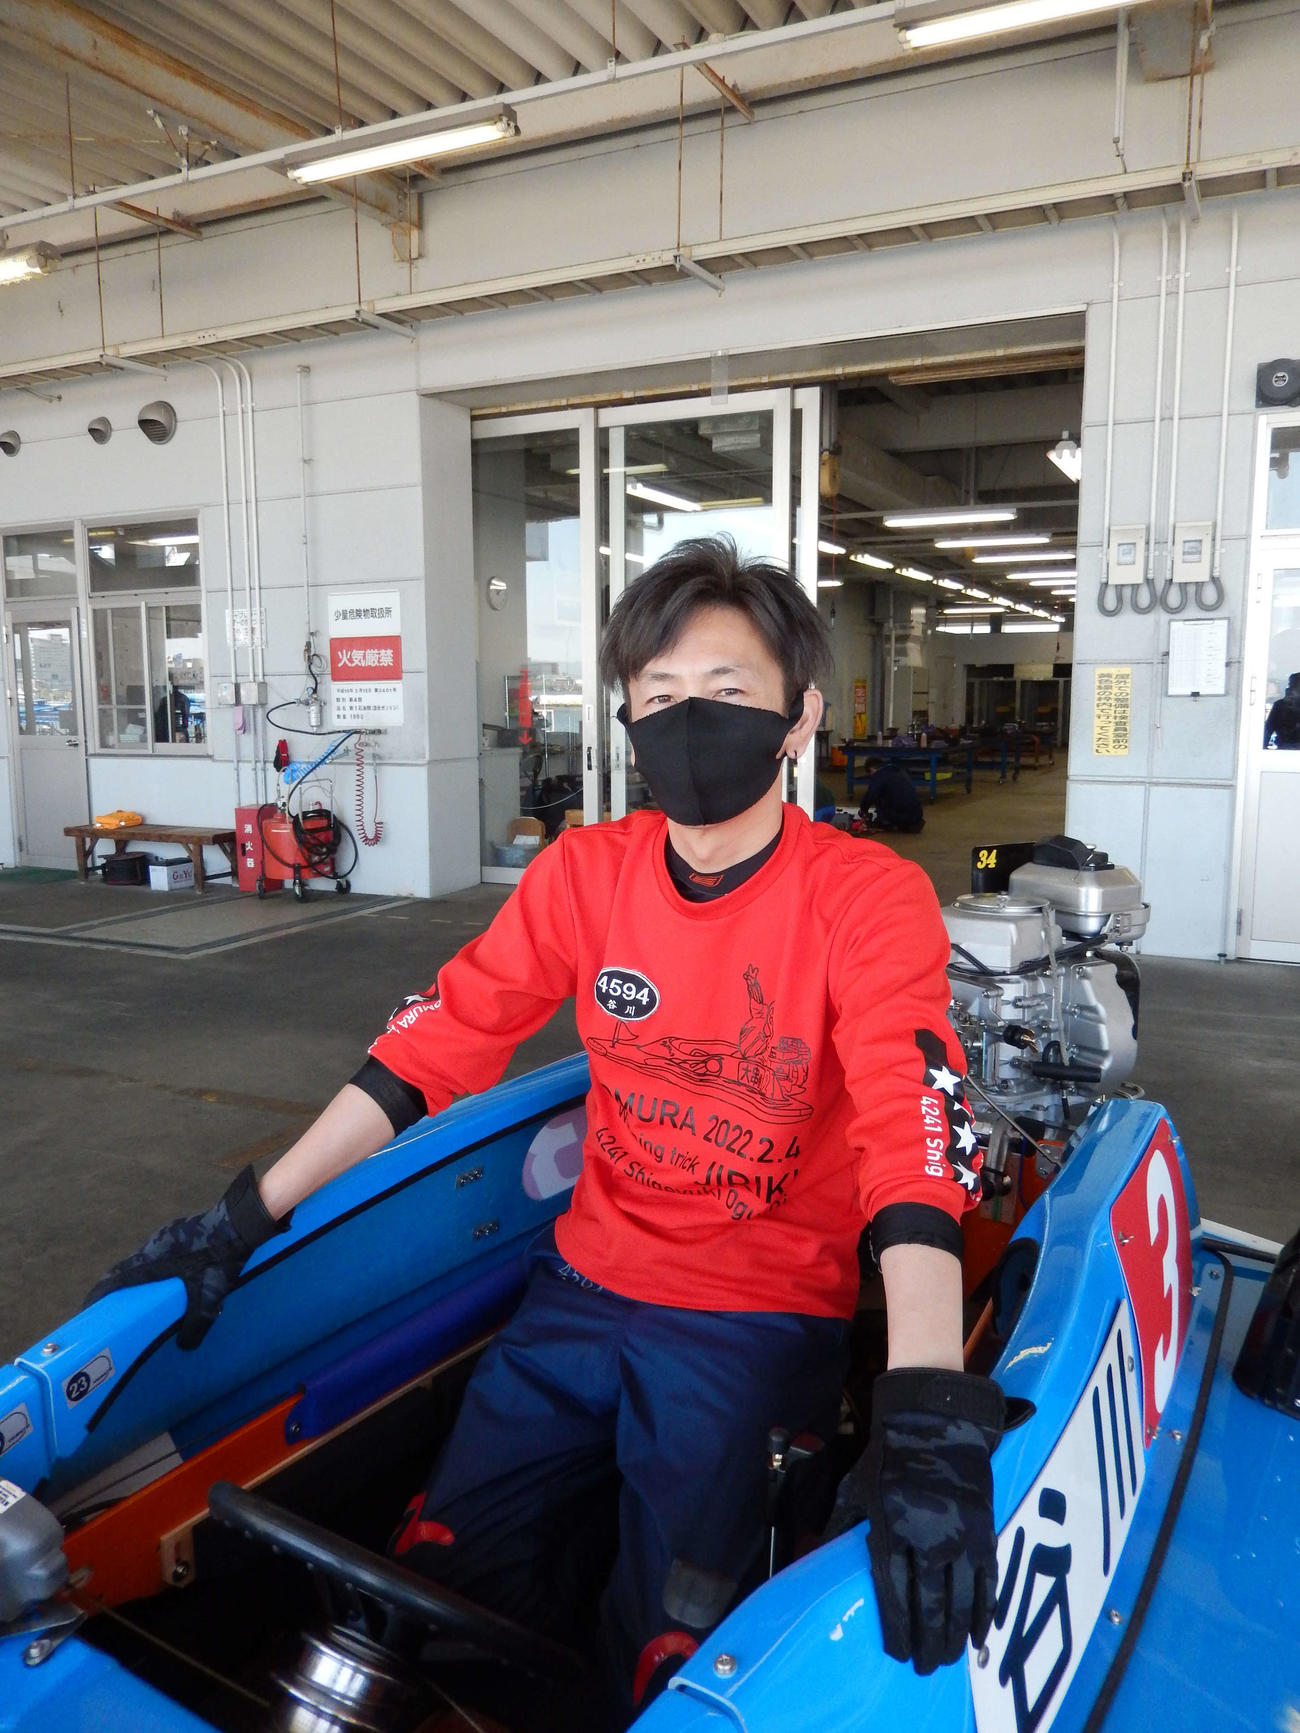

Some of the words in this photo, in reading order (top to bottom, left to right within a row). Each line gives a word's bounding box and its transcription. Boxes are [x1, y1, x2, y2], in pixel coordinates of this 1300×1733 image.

[334, 607, 392, 621] 少量危険物取扱所
[338, 649, 394, 667] 火気厳禁
[244, 824, 255, 868] 消火器
[976, 849, 997, 869] 34
[597, 975, 650, 1005] 4594
[607, 999, 636, 1016] 谷川
[920, 1095, 943, 1132] 4241
[703, 1114, 800, 1163] 2022.2.4
[670, 1146, 699, 1175] trick
[1146, 1149, 1180, 1414] 3
[68, 1376, 89, 1399] 23
